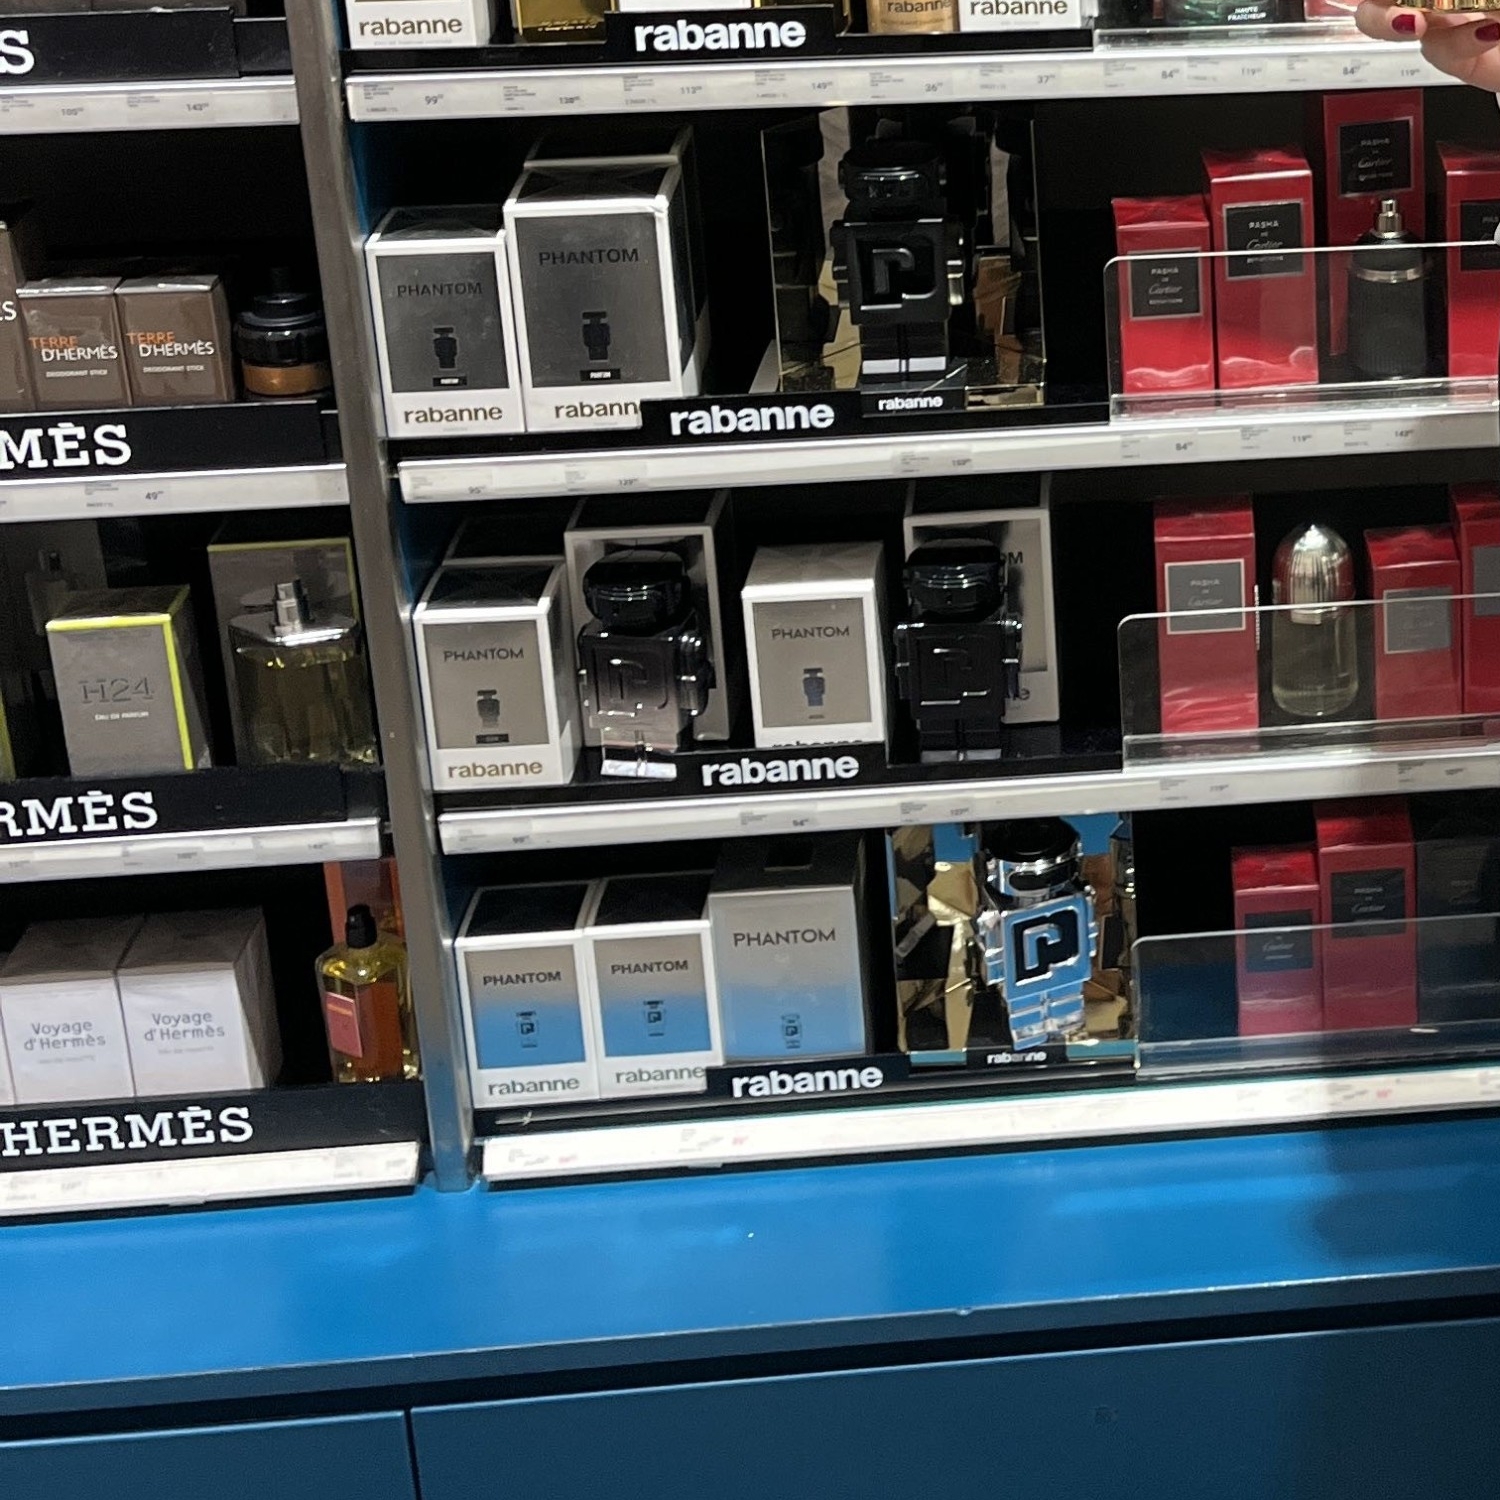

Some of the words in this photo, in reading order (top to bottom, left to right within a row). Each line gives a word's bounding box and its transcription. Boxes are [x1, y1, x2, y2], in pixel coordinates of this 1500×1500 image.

[359, 17, 462, 37] rabanne
[635, 18, 806, 52] rabanne
[1361, 138, 1390, 147] PASHA
[1358, 156, 1393, 169] Cartier
[1248, 220, 1280, 230] PASHA
[1247, 239, 1284, 252] Cartier
[539, 248, 639, 265] PHANTOM
[1150, 266, 1179, 275] PASHA
[397, 281, 482, 298] PHANTOM
[1148, 284, 1182, 296] Cartier
[29, 335, 80, 349] TERRE
[126, 331, 176, 345] TERRE
[41, 345, 119, 362] D'HERMÈS
[139, 339, 215, 358] D'HERMÈS
[554, 400, 641, 419] rabann
[878, 394, 943, 411] rabanne
[404, 404, 503, 424] rabanne
[671, 402, 835, 436] rabanne
[0, 422, 132, 470] MÈS
[772, 626, 850, 640] PHANTOM
[444, 648, 524, 662] PHANTOM
[78, 677, 155, 704] H24
[448, 761, 543, 779] rabanne
[702, 755, 859, 787] rabanne
[734, 929, 836, 947] PHANTOM
[611, 960, 689, 975] PHANTOM
[483, 971, 562, 986] PHANTOM
[152, 1012, 212, 1027] Voyage
[32, 1021, 93, 1037] Voyage
[144, 1026, 225, 1042] d'Hermès
[24, 1035, 106, 1051] d'Hermès
[987, 1051, 1047, 1065] rabanne
[615, 1065, 706, 1084] rabanne
[732, 1065, 883, 1097] rabanne
[489, 1076, 580, 1096] rabanne
[0, 1107, 253, 1157] HERMÈS
